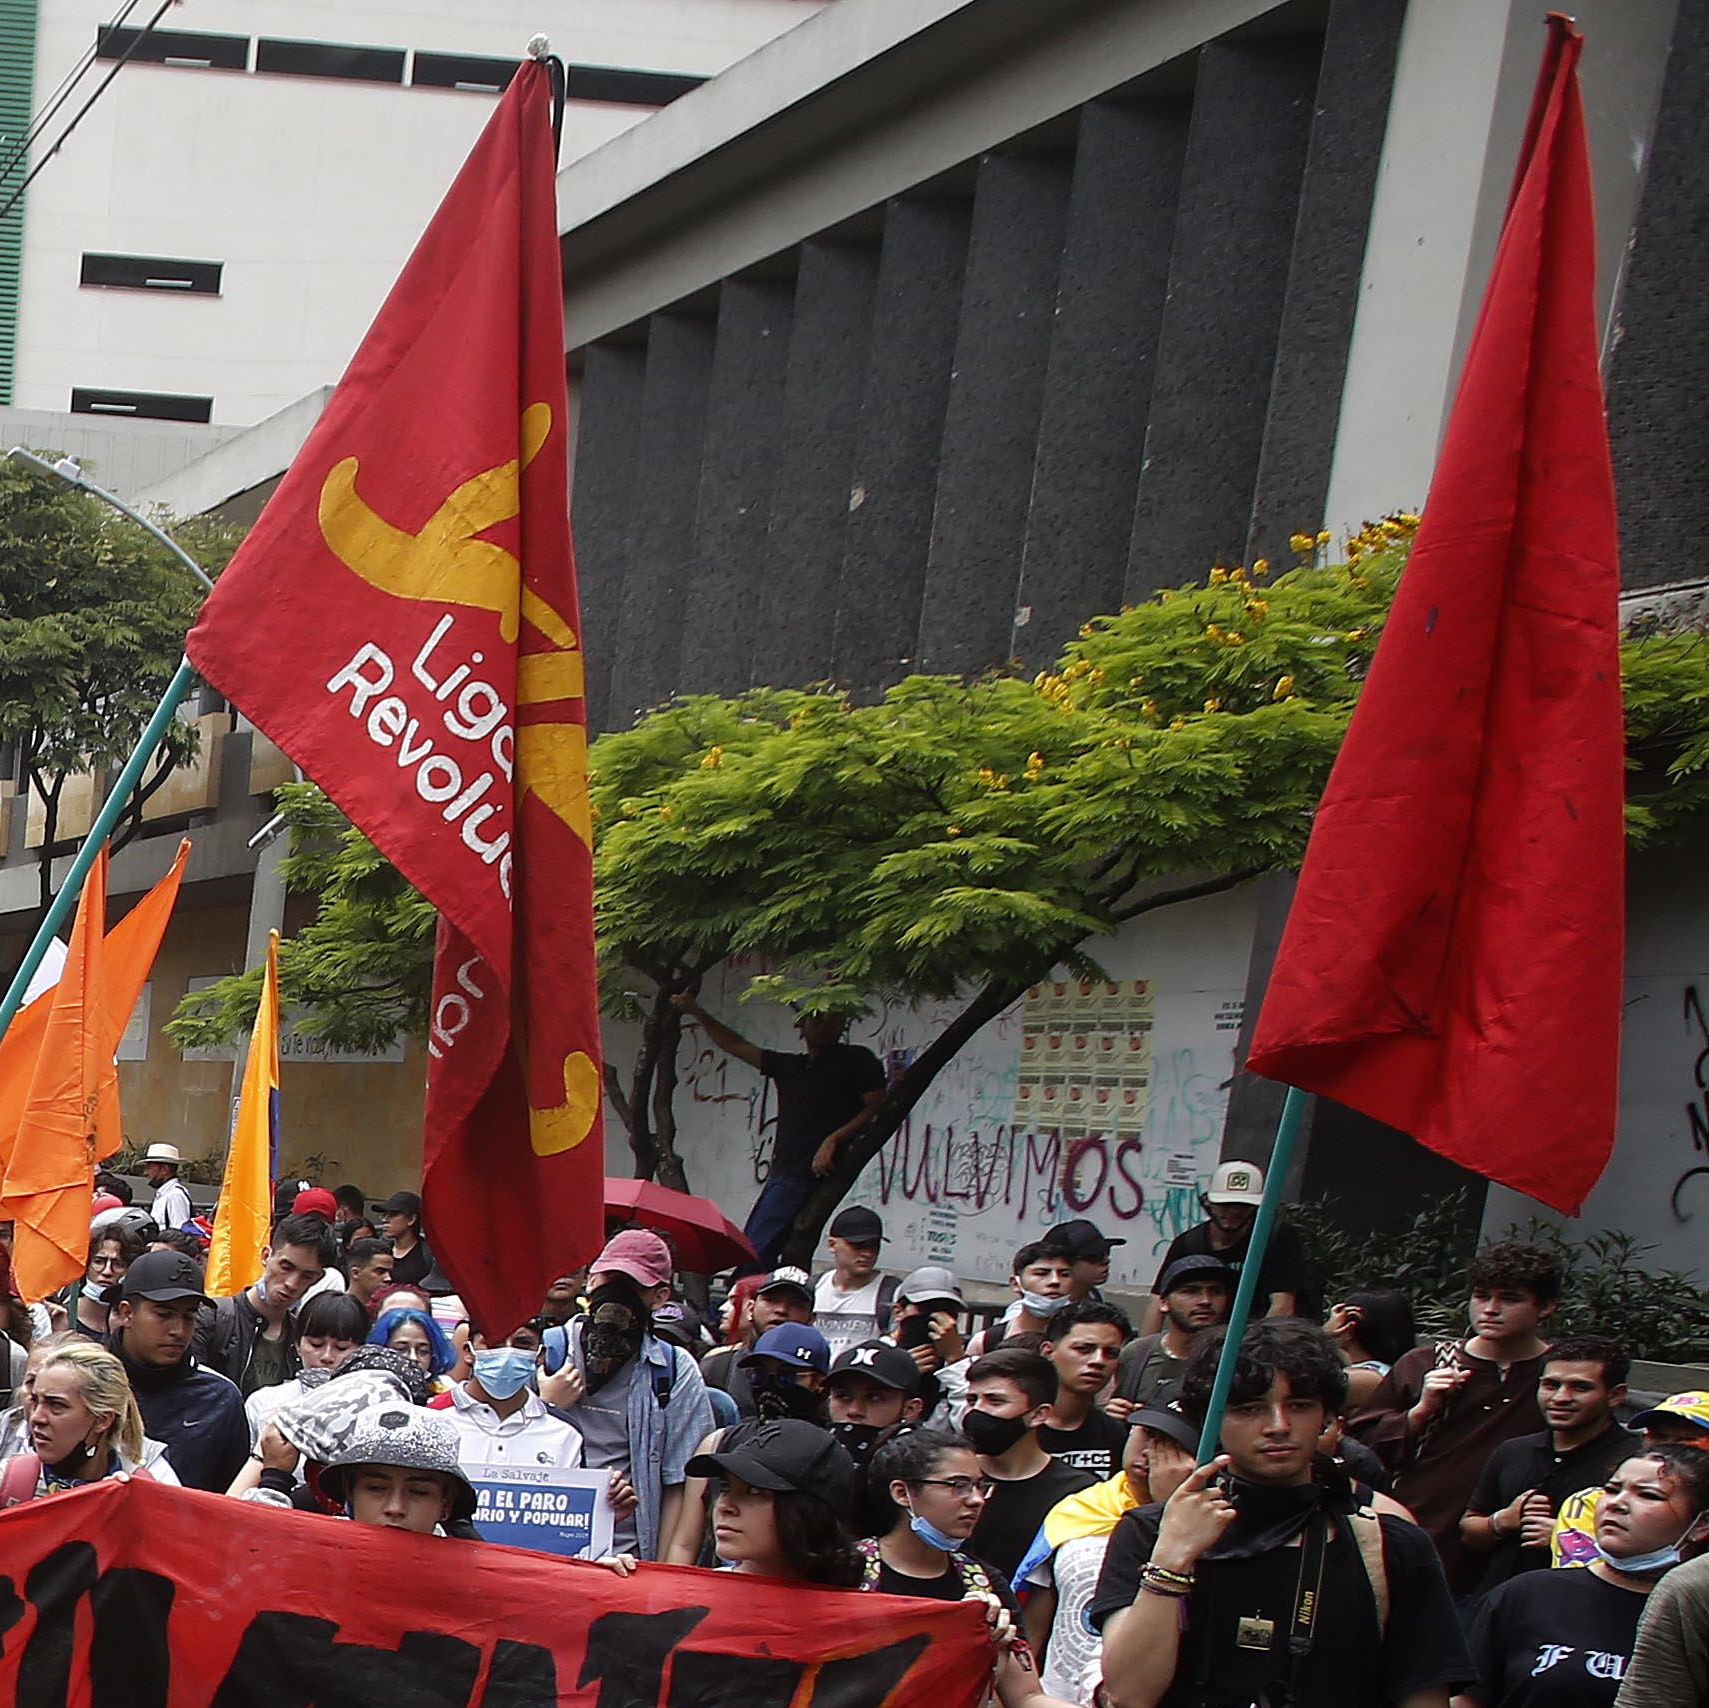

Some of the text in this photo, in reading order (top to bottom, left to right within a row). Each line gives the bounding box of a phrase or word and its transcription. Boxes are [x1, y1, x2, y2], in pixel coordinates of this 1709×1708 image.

[880, 1118, 1143, 1220] VULVIMOS
[496, 1490, 513, 1508] EL
[520, 1492, 568, 1511] PARO
[509, 1510, 521, 1524] Y
[523, 1511, 590, 1530] POPULAR!
[1297, 1590, 1315, 1625] Nikon
